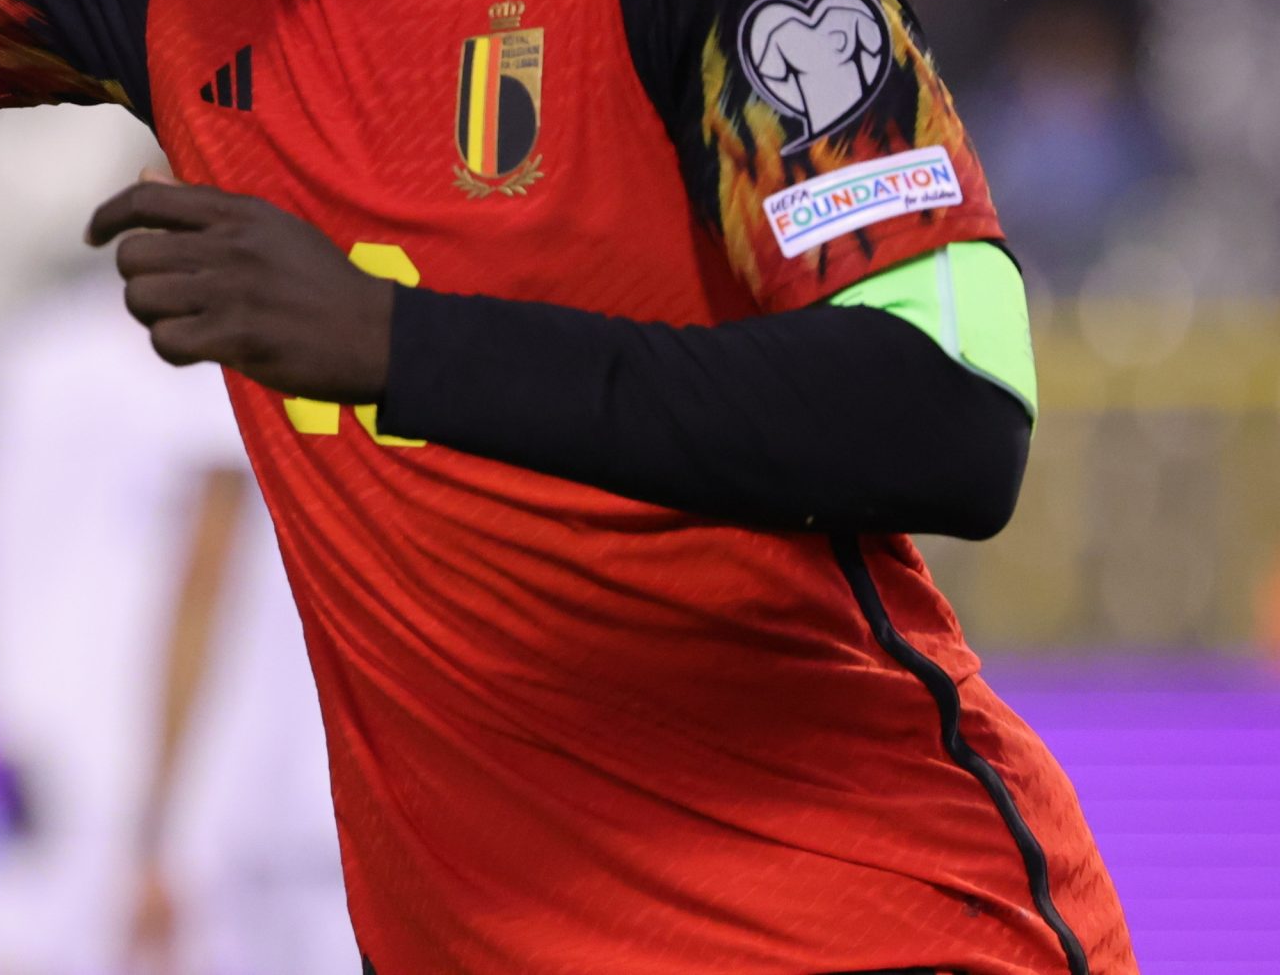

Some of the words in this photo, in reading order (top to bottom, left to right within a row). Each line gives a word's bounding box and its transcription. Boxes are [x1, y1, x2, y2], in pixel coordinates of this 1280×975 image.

[771, 189, 810, 214] UEFA
[776, 164, 951, 236] FOUNDATION
[904, 195, 918, 208] for
[921, 189, 957, 201] children
